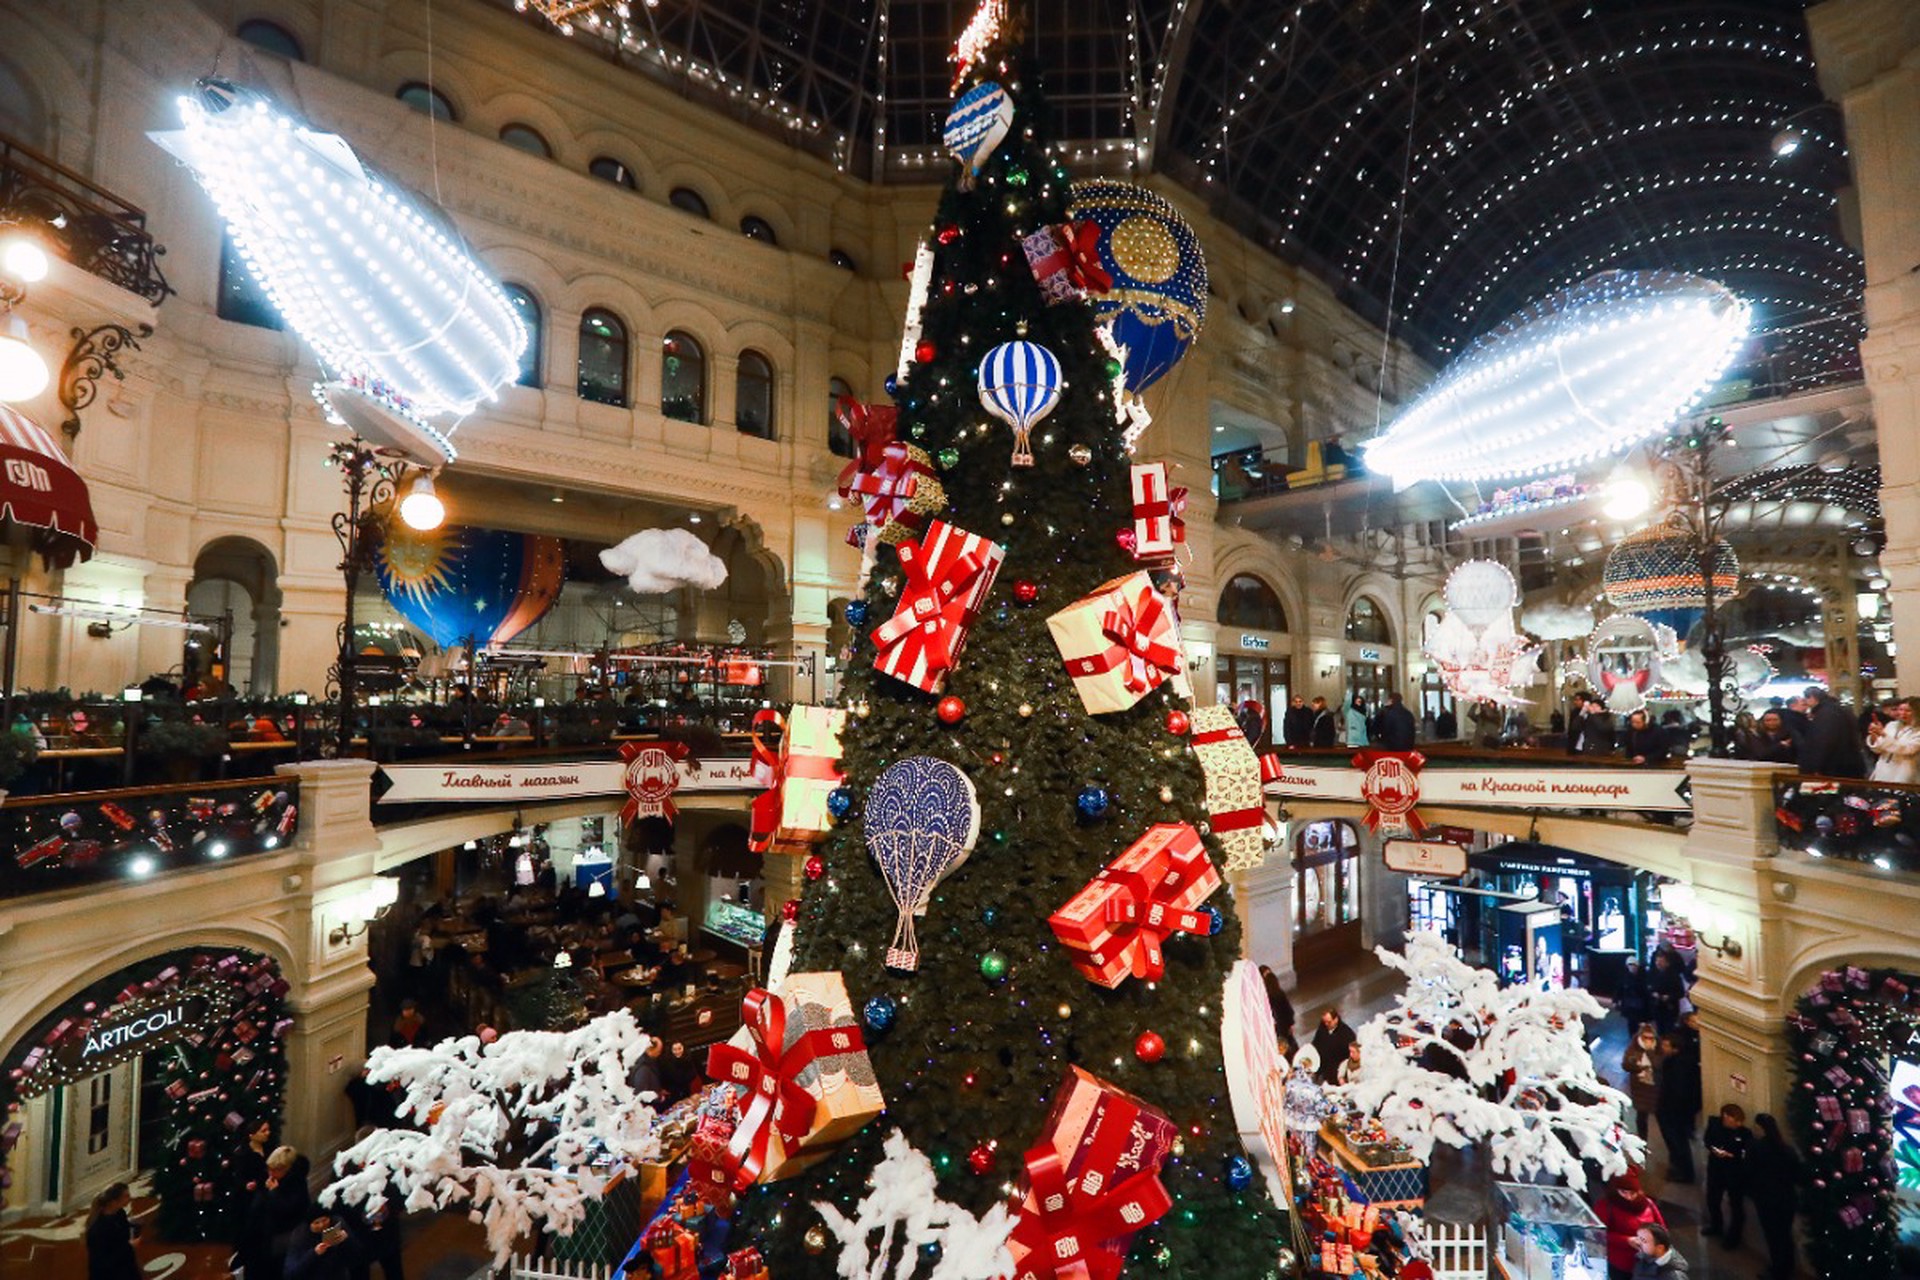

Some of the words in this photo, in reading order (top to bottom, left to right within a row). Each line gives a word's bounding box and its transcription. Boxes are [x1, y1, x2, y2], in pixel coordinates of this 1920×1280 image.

[441, 771, 513, 788] Главный
[519, 775, 580, 788] магазин
[1460, 781, 1478, 791] на
[1481, 777, 1547, 795] Красной
[1550, 784, 1630, 798] площади
[1420, 849, 1428, 858] 2
[82, 1006, 182, 1058] ARTICOLI
